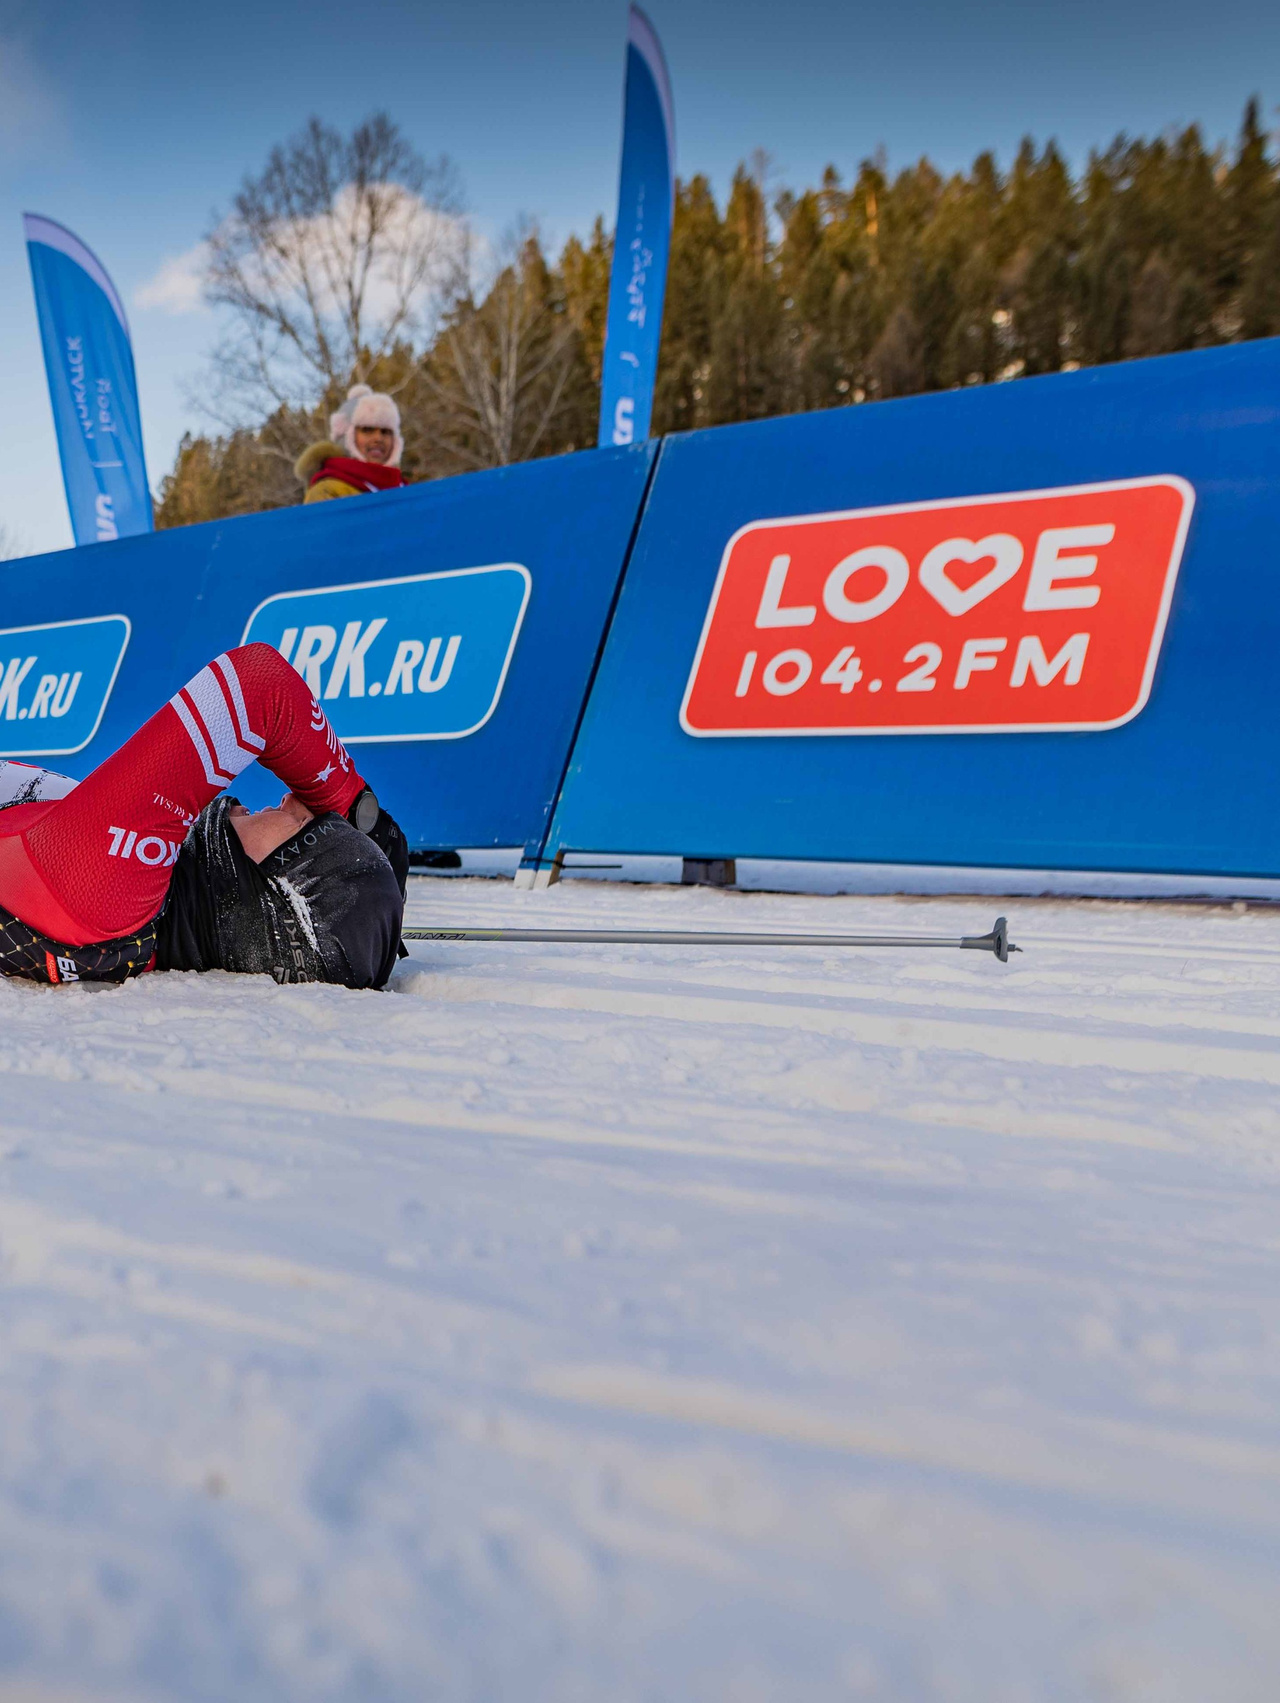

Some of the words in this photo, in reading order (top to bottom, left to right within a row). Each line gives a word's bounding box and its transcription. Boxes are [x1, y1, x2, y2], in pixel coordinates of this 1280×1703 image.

[755, 523, 1116, 629] LOVE
[152, 792, 186, 818] RUSAL
[107, 825, 182, 867] KOIL
